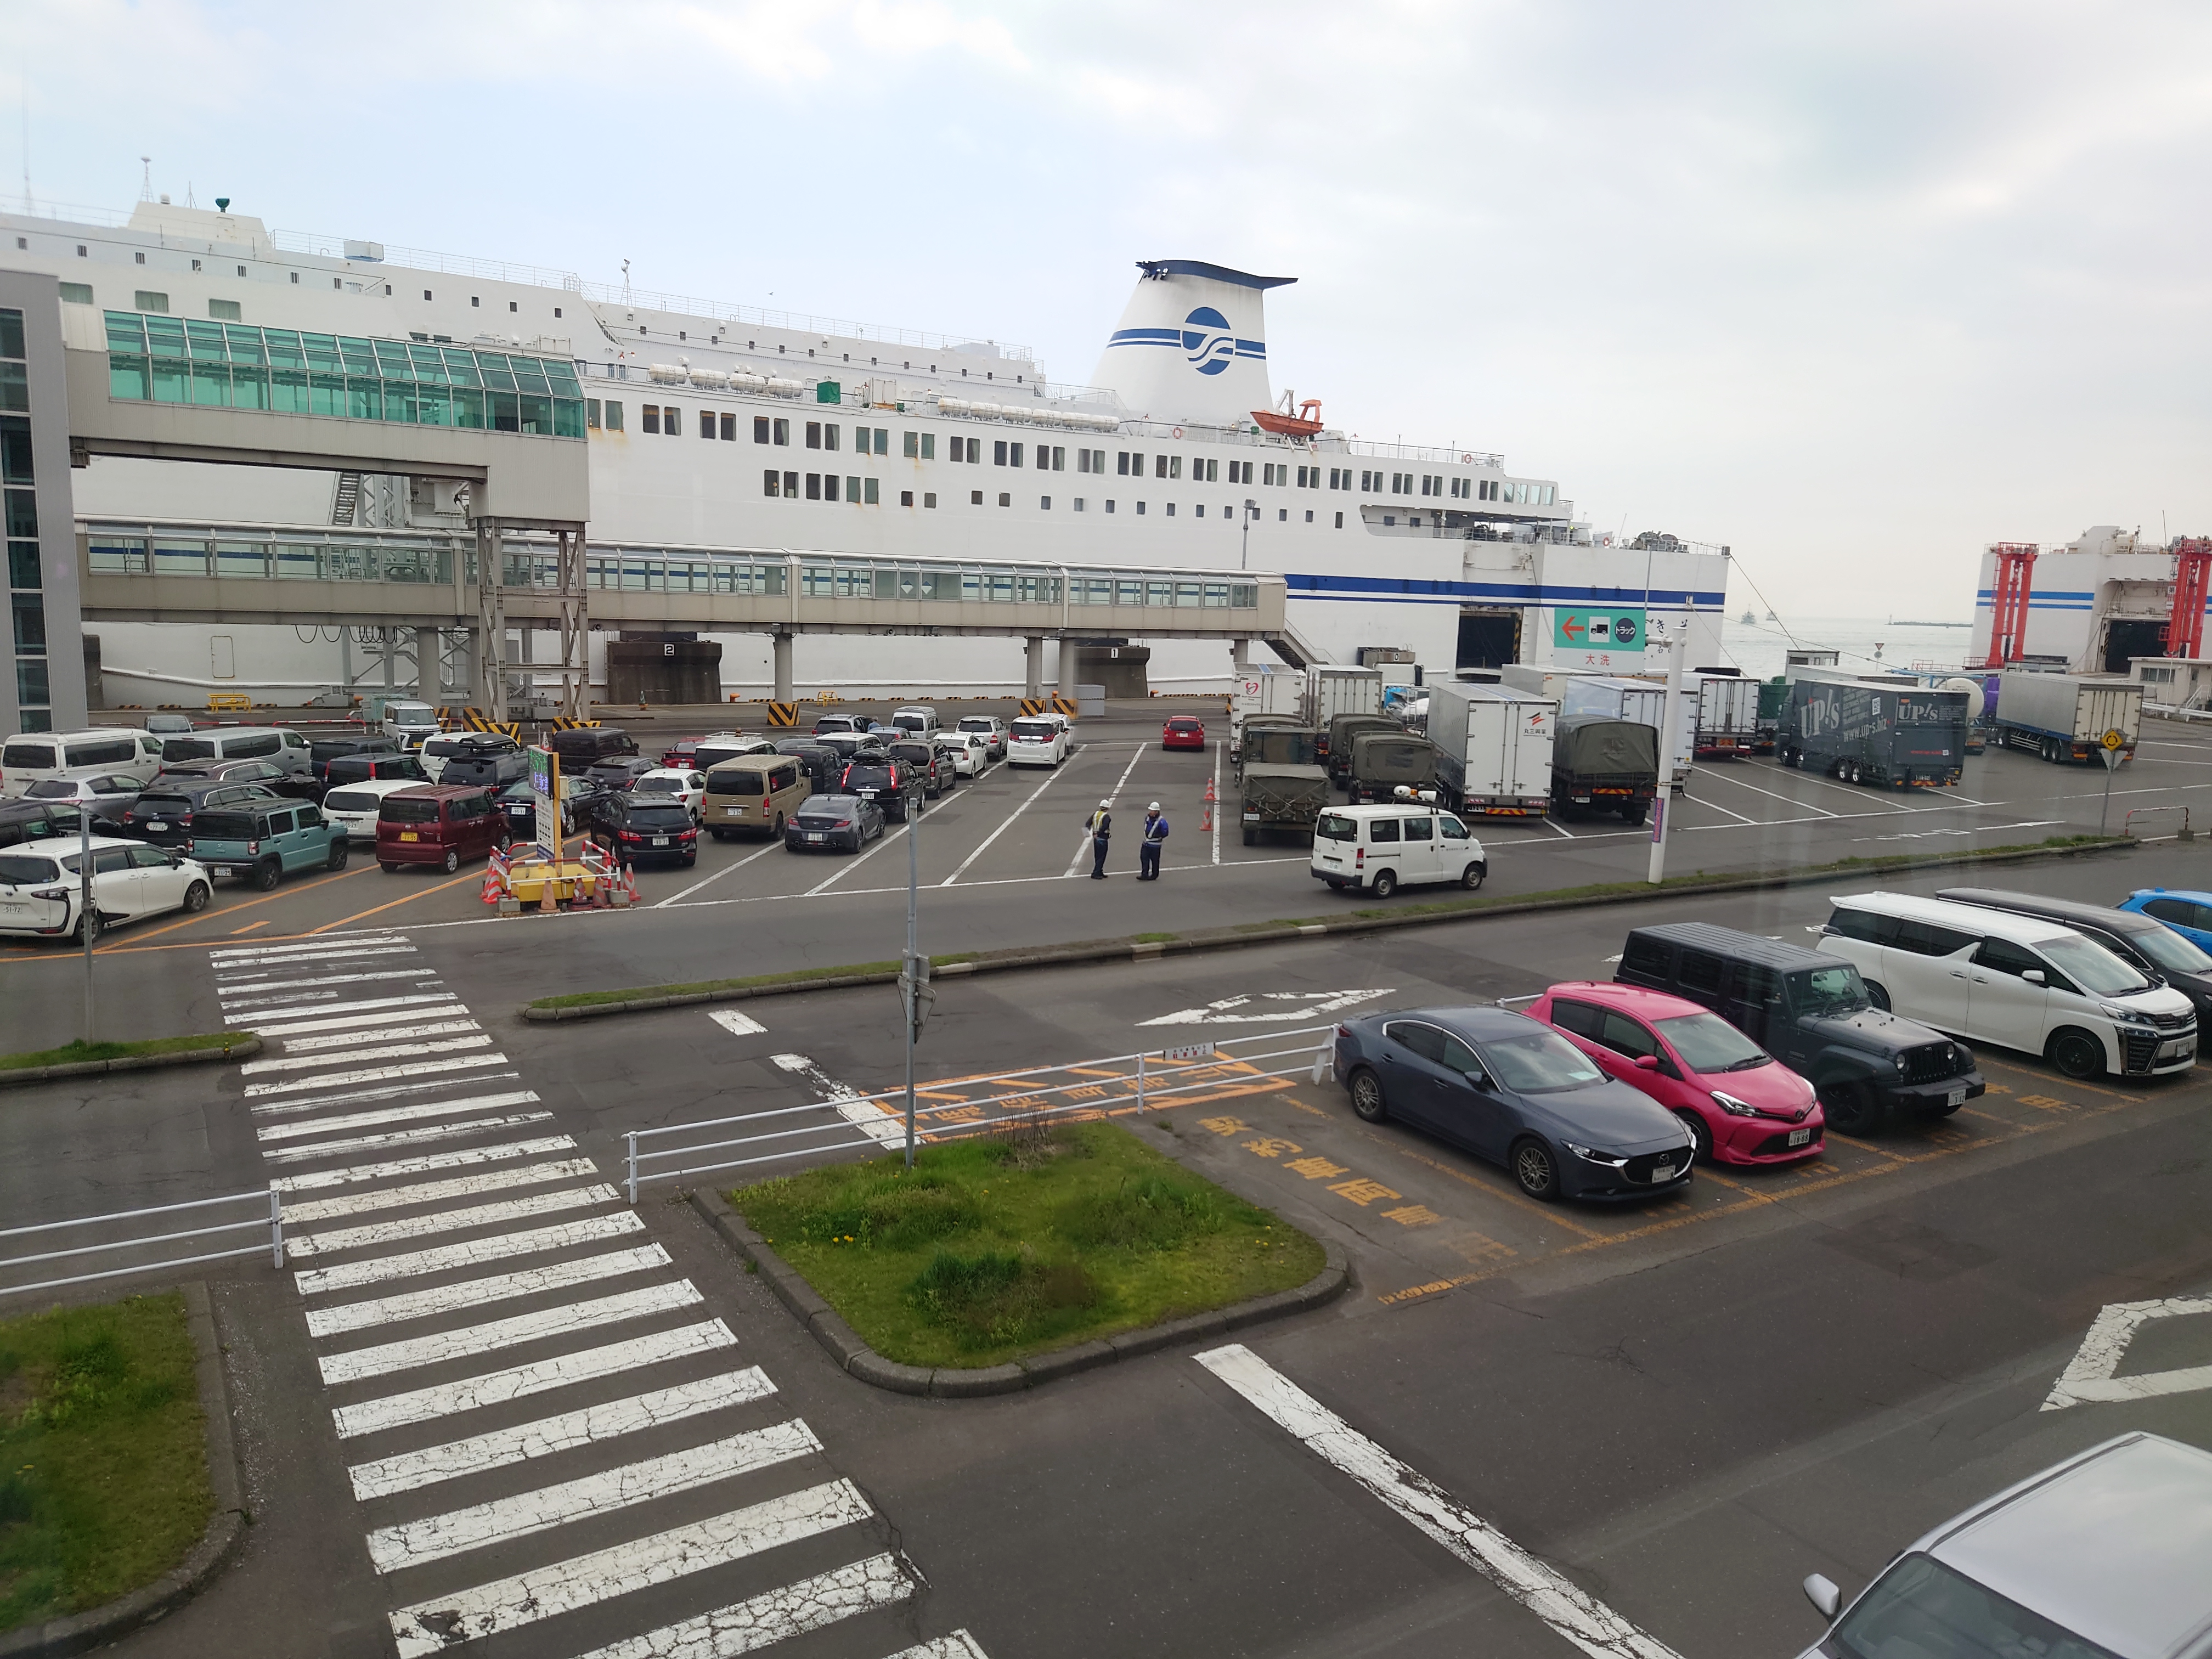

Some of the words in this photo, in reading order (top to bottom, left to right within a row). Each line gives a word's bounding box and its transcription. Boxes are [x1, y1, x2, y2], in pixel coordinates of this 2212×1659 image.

[1615, 627, 1635, 635] トラック
[666, 646, 673, 654] 2
[1585, 653, 1610, 666] 大洗
[1843, 715, 1887, 742] www.up-s.biz
